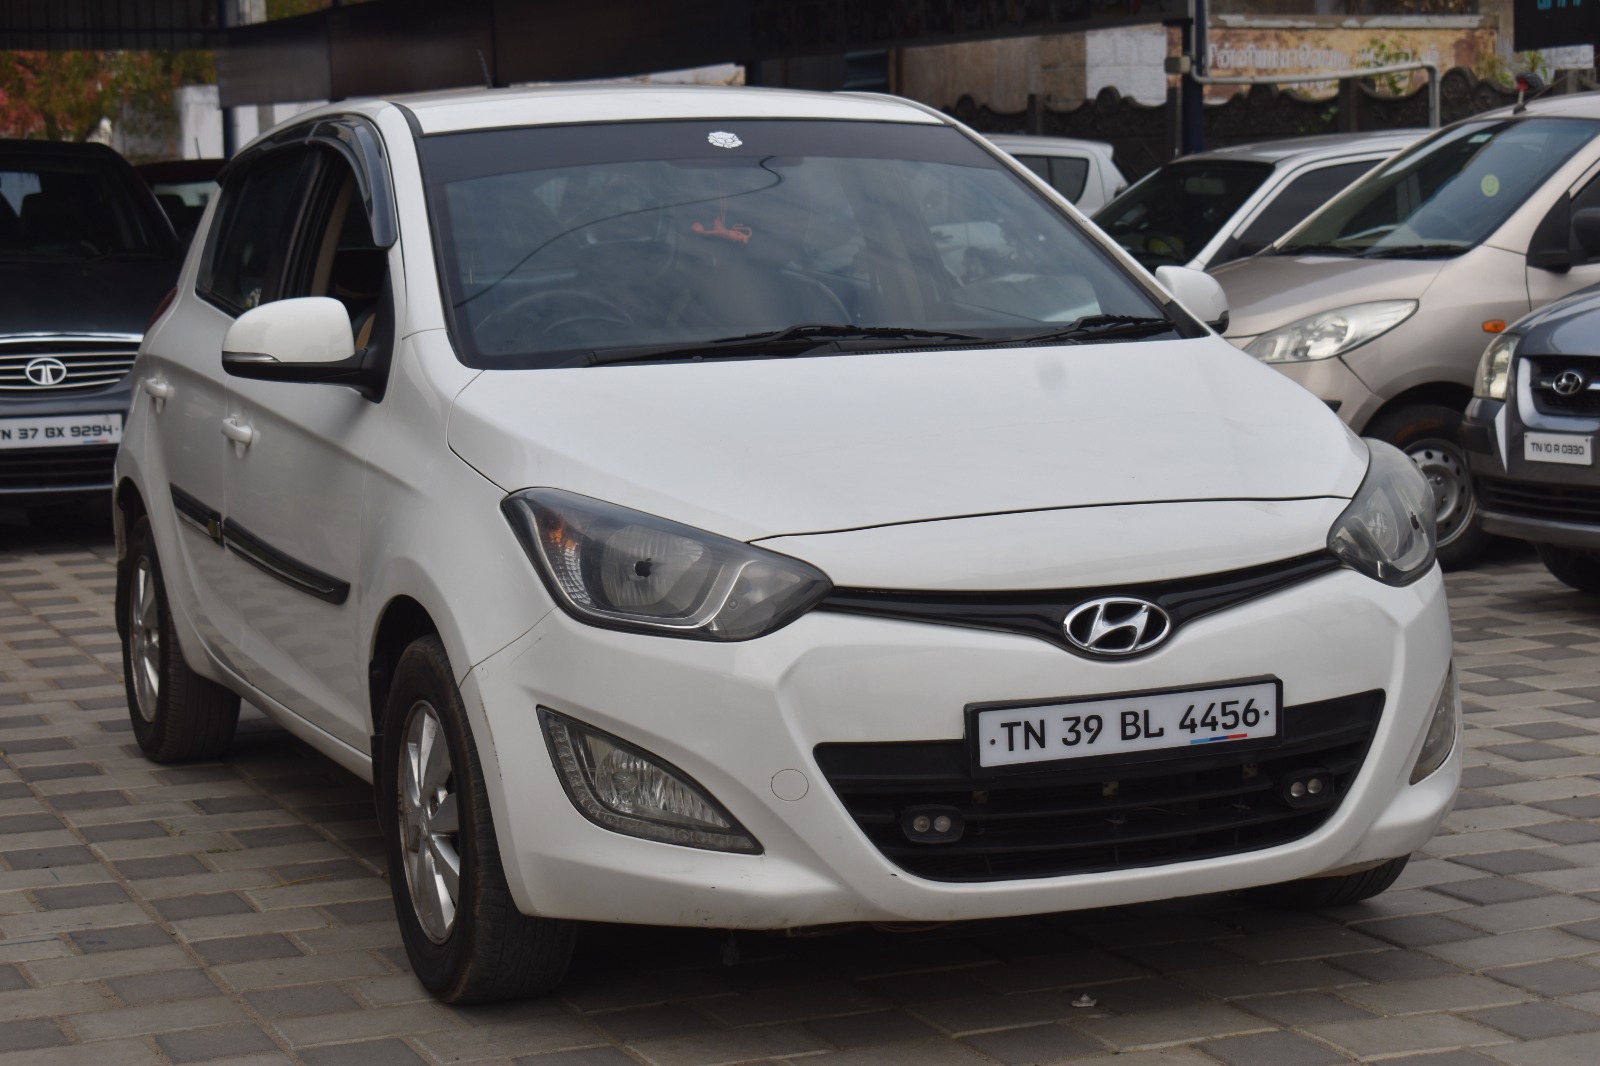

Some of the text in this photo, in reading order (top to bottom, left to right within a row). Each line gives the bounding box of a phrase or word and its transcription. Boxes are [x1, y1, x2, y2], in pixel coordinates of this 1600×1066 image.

[0, 428, 11, 440] N
[18, 428, 39, 440] 37
[70, 425, 113, 437] 9294
[1530, 442, 1584, 455] TN 10 R 0330
[1000, 698, 1261, 751] TN 39 BL 4456
